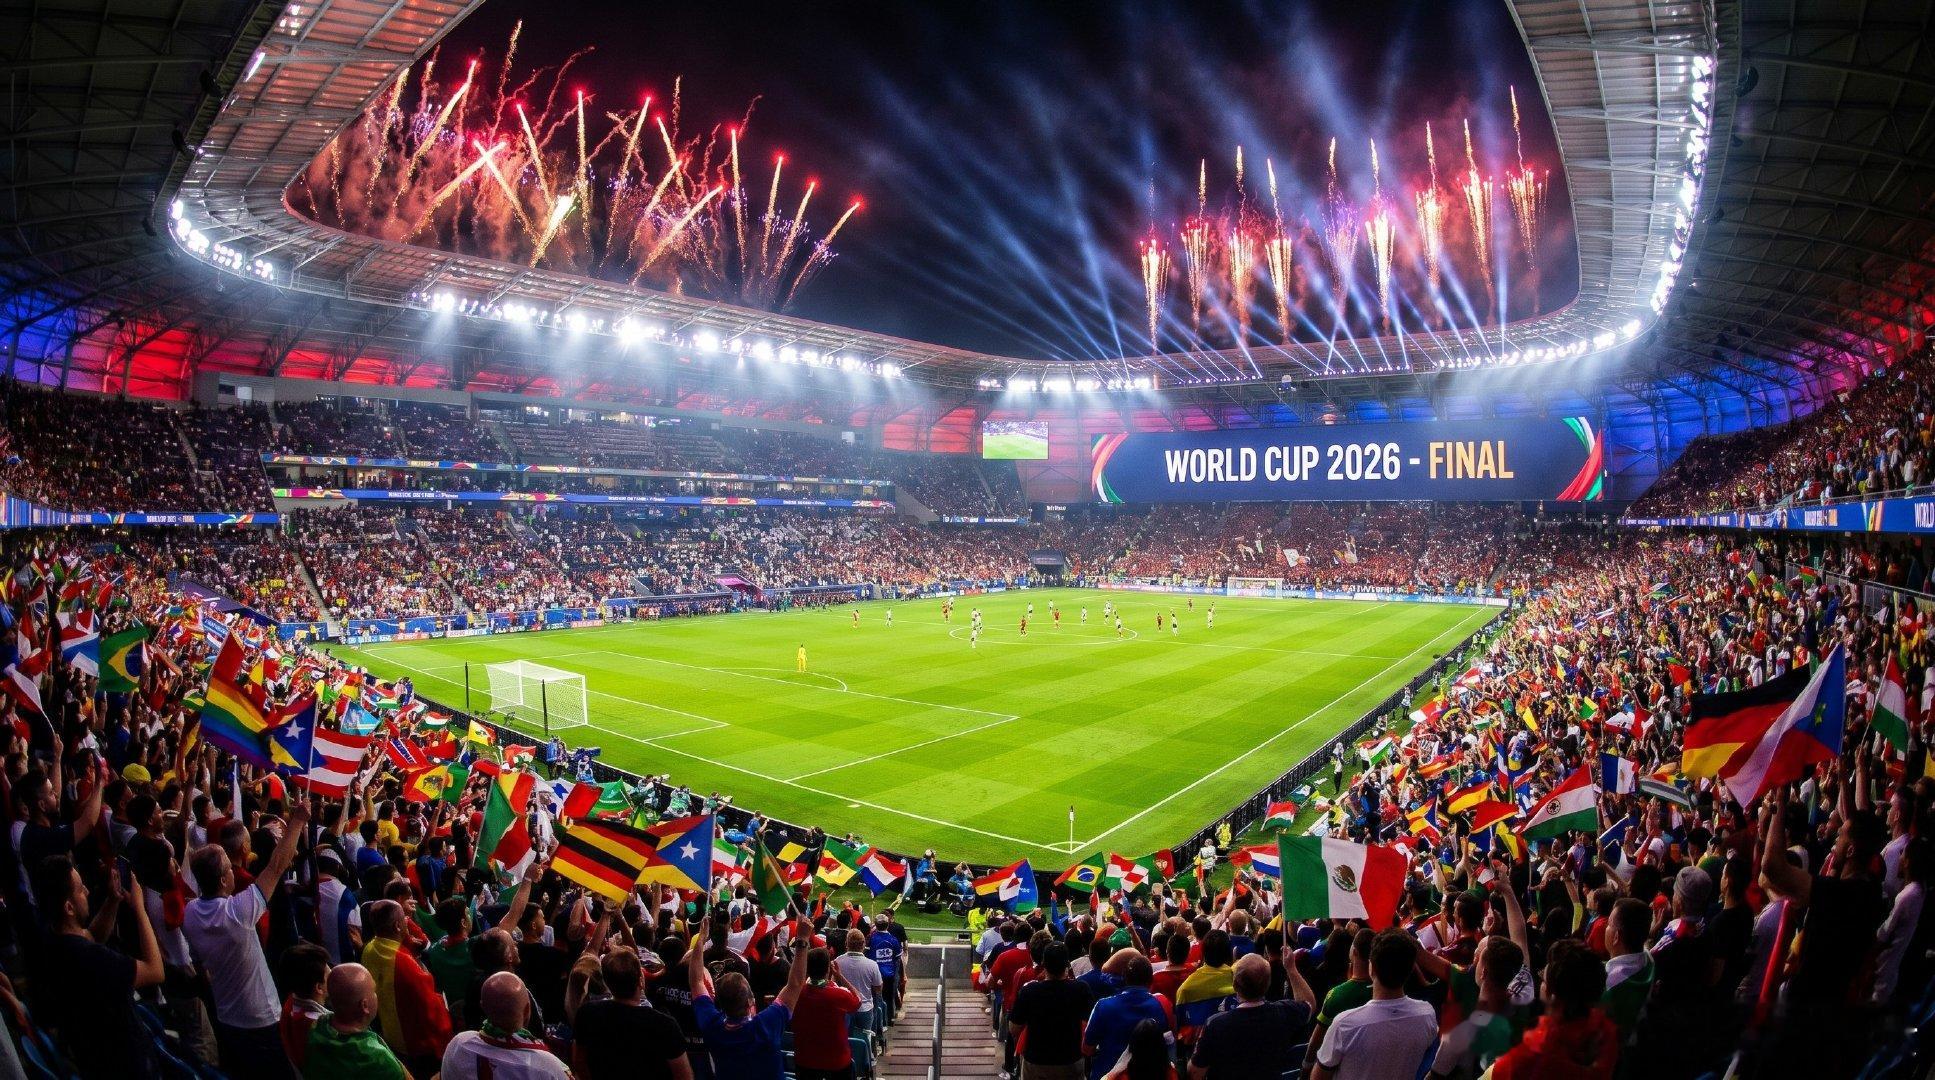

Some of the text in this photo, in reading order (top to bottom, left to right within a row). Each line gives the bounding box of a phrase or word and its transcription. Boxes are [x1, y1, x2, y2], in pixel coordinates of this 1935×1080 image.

[1164, 447, 1257, 483] WORLD
[1264, 445, 1320, 482] CUP
[1327, 442, 1401, 481] 2026
[1429, 440, 1514, 479] FINAL
